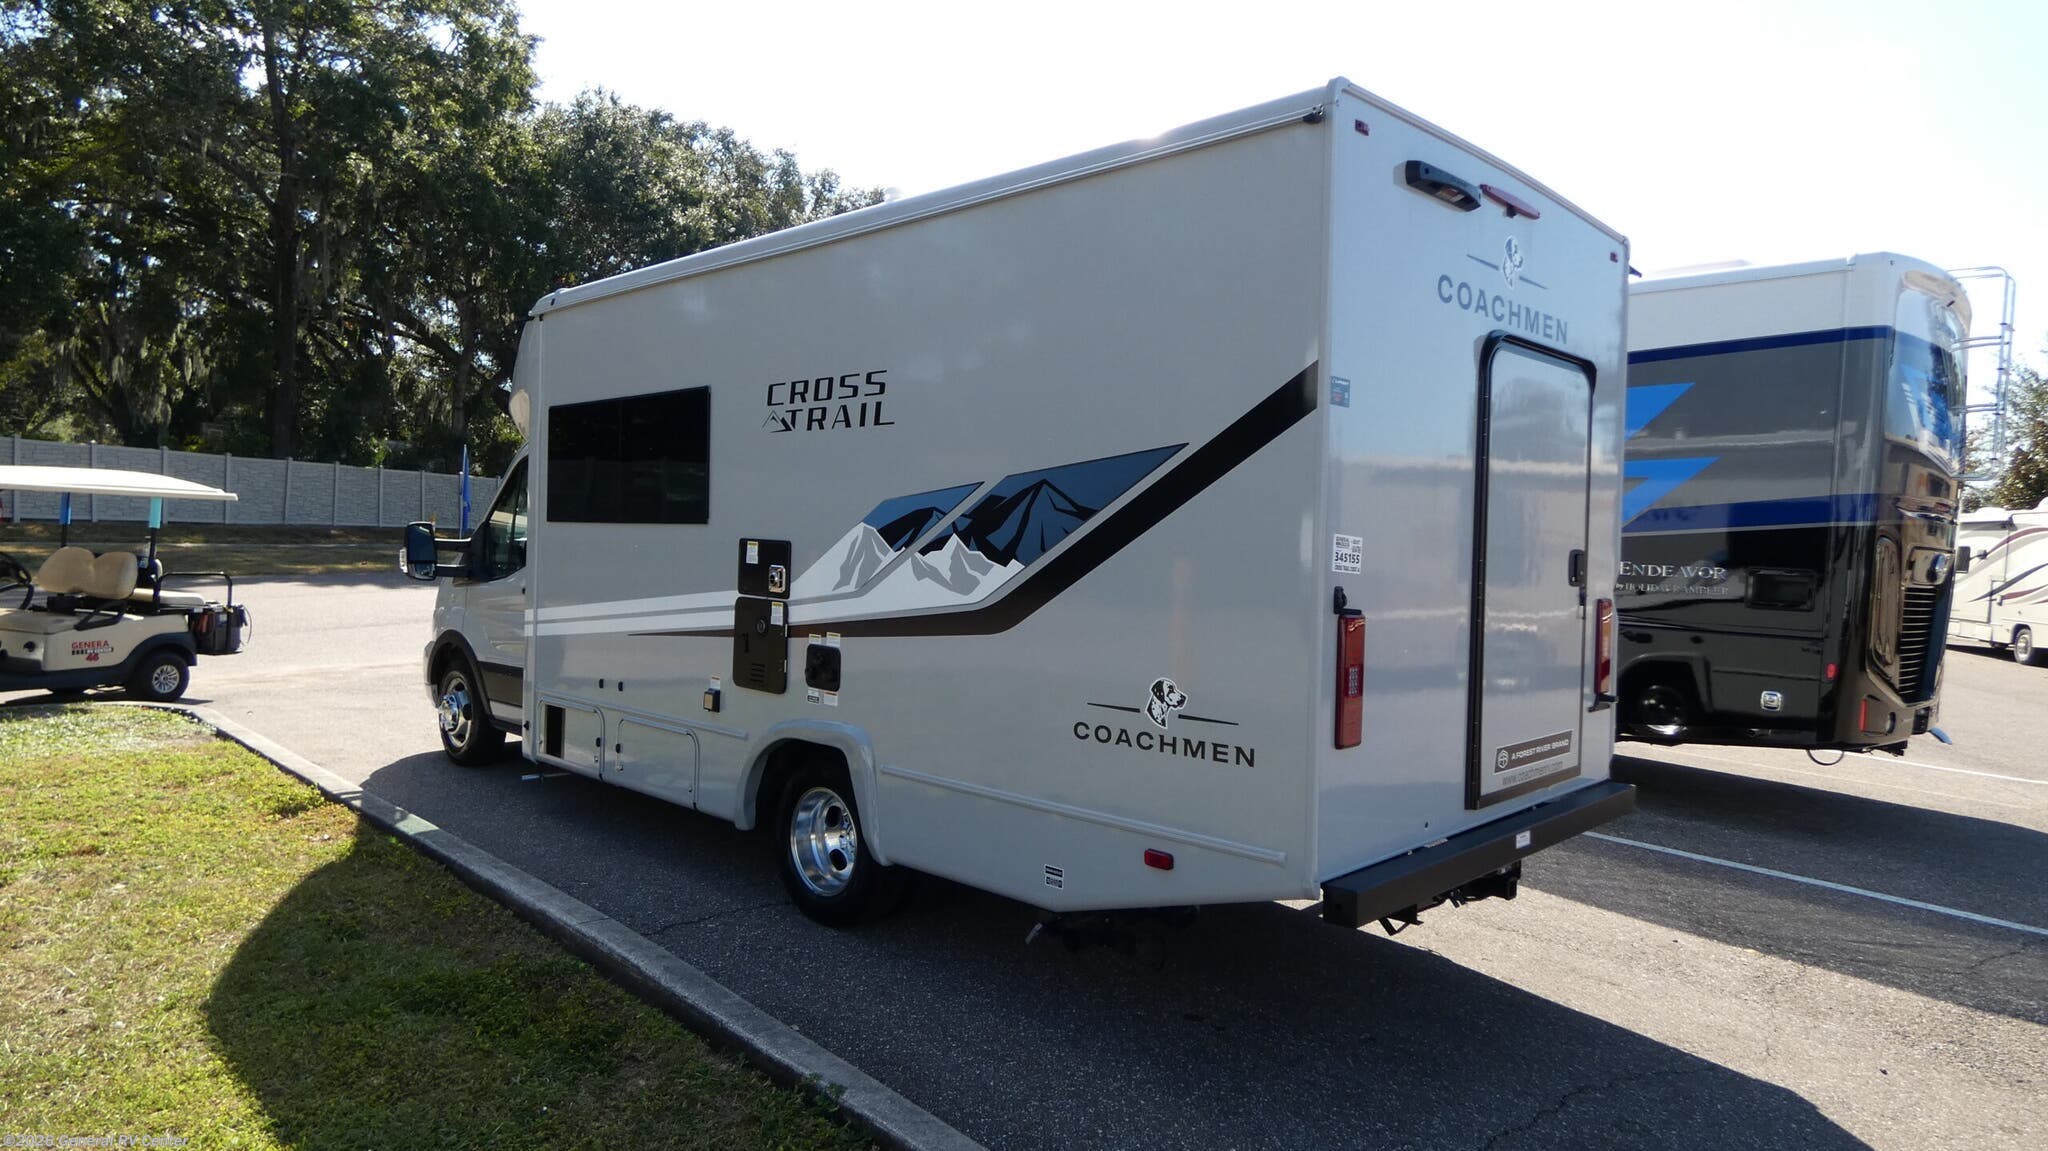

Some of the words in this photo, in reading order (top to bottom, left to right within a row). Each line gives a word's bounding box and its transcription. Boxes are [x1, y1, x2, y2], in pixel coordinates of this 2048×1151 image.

[1437, 274, 1569, 345] COACHMEN
[766, 370, 888, 406] CROSS
[785, 401, 895, 431] TRAIL
[1334, 551, 1360, 564] 345155
[1619, 561, 1729, 580] ENDEAVOR
[1073, 721, 1255, 768] COACHMEN
